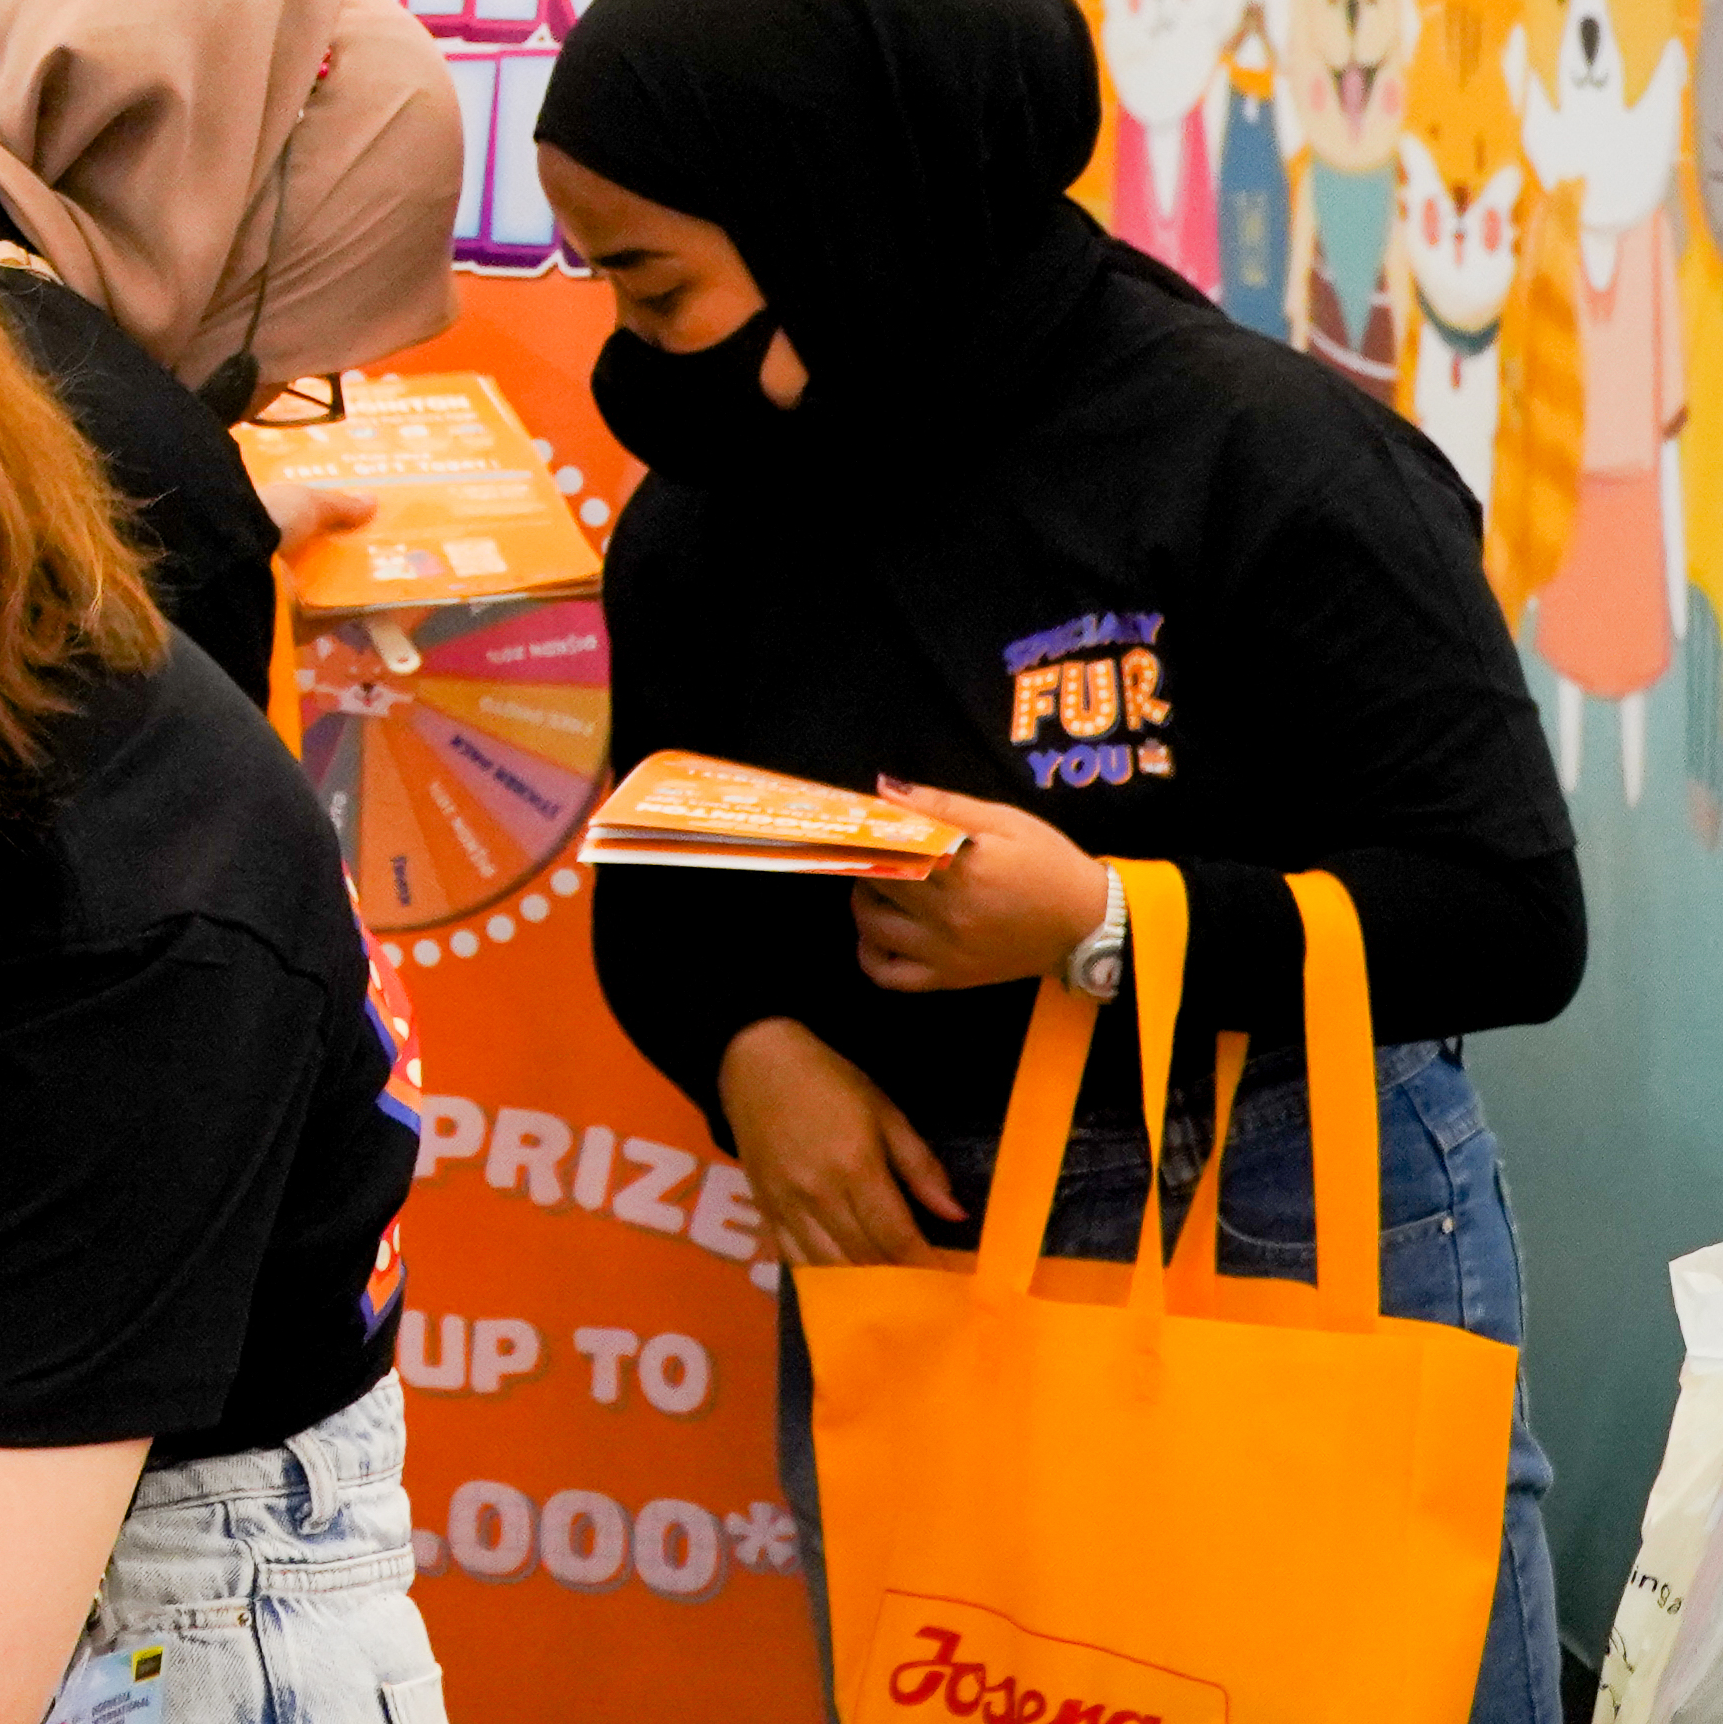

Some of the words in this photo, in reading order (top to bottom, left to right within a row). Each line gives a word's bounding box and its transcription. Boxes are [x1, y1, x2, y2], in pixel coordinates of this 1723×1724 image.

[1010, 647, 1173, 746] FUR
[1027, 743, 1135, 790] YOU
[413, 1094, 781, 1294] PRIZE
[399, 1309, 542, 1395] UP
[573, 1326, 713, 1416] TO
